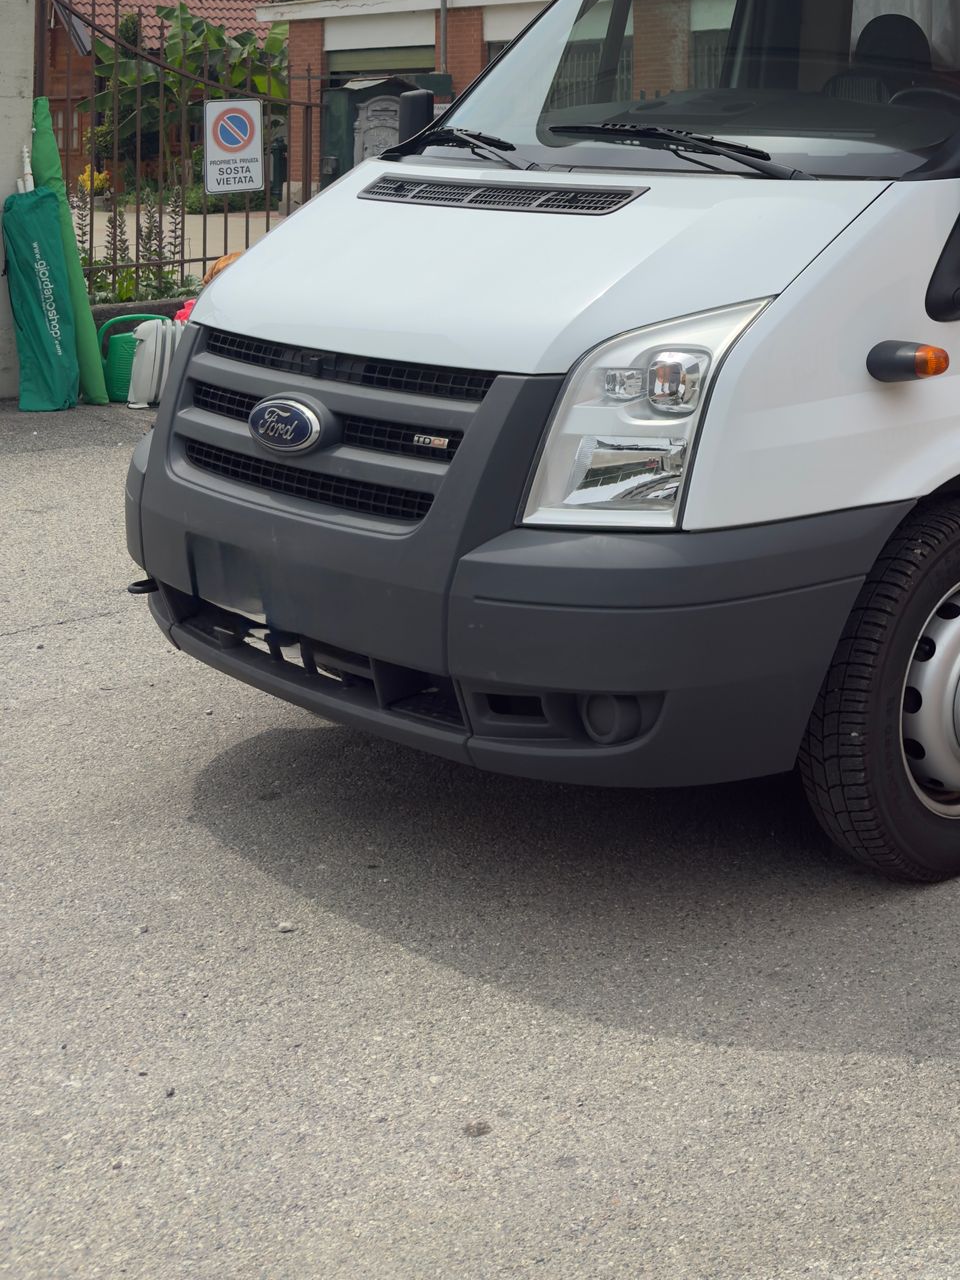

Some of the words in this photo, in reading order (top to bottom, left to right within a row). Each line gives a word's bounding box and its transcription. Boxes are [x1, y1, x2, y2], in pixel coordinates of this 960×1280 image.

[218, 165, 251, 176] SOSTA
[215, 175, 255, 186] VIETATA
[257, 407, 299, 440] Ford
